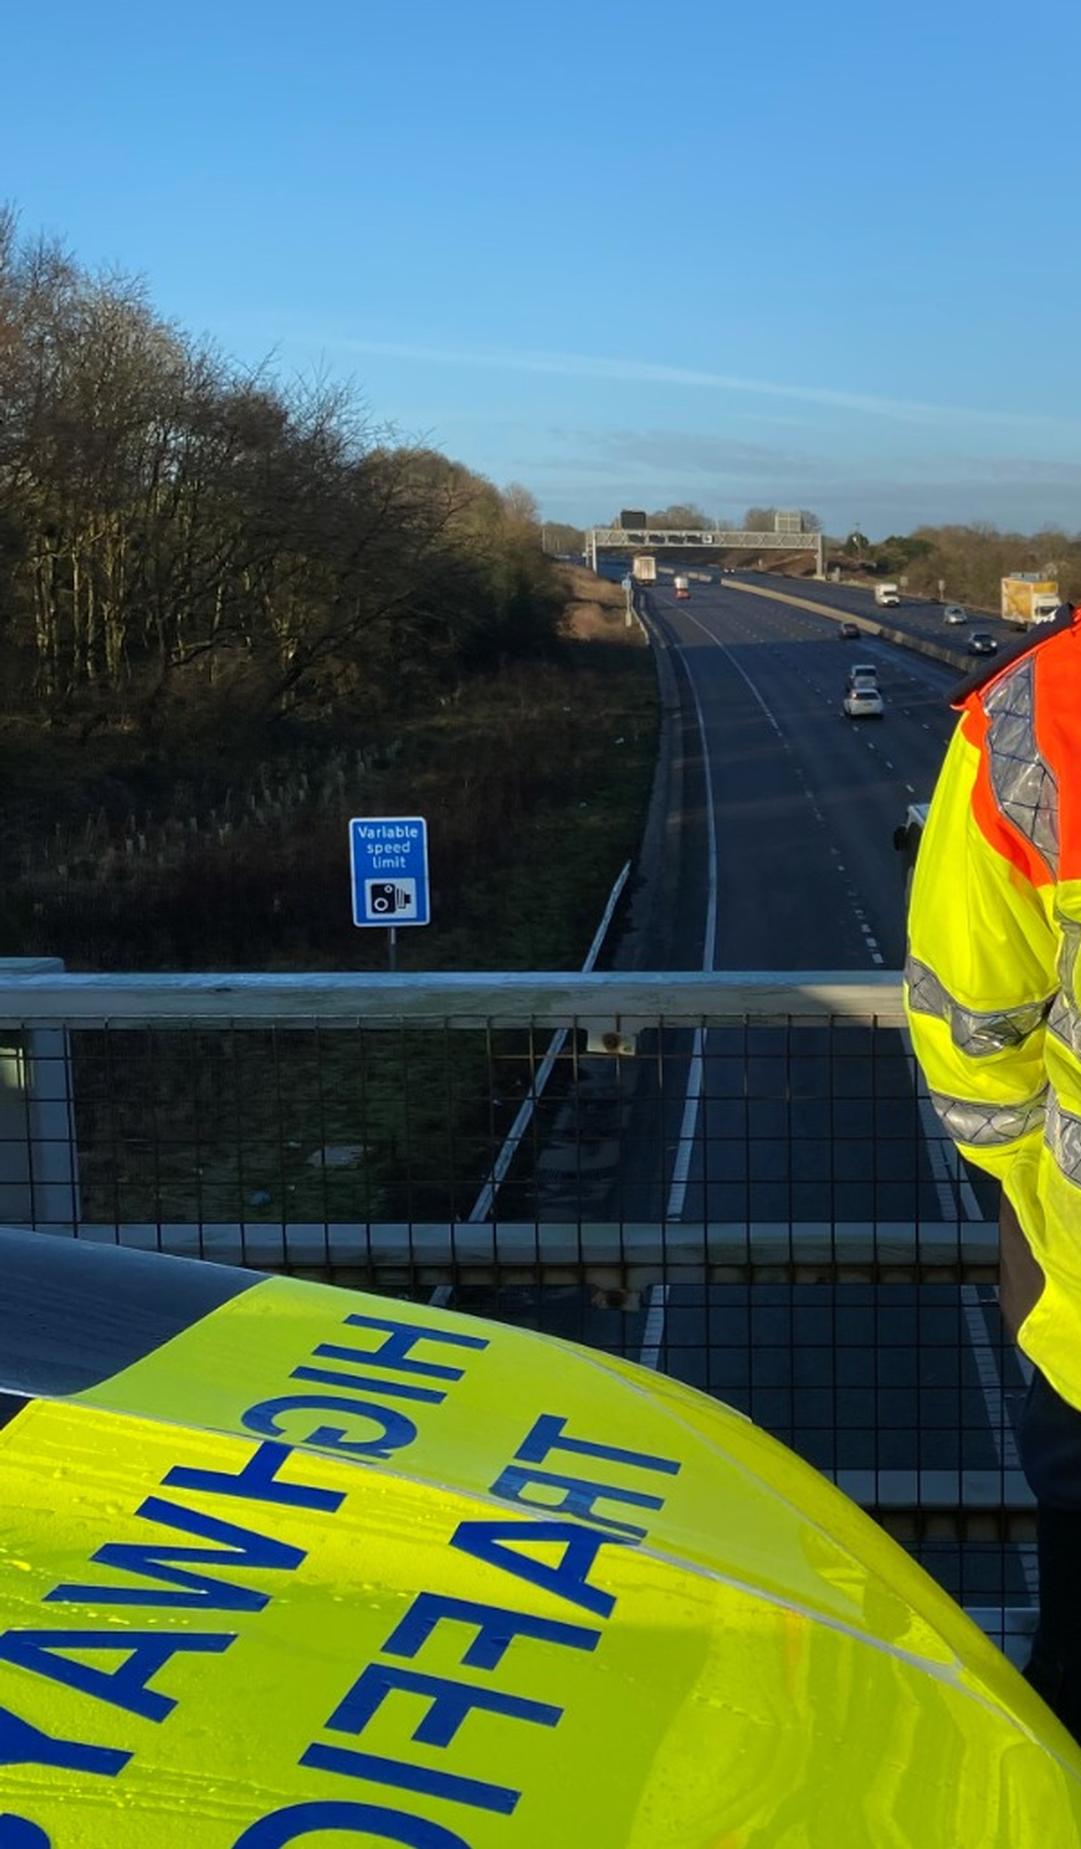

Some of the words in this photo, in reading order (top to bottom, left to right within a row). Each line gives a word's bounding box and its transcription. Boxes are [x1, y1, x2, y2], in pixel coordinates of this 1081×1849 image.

[358, 825, 418, 838] Variable
[367, 841, 411, 855] speed
[372, 856, 406, 869] limit
